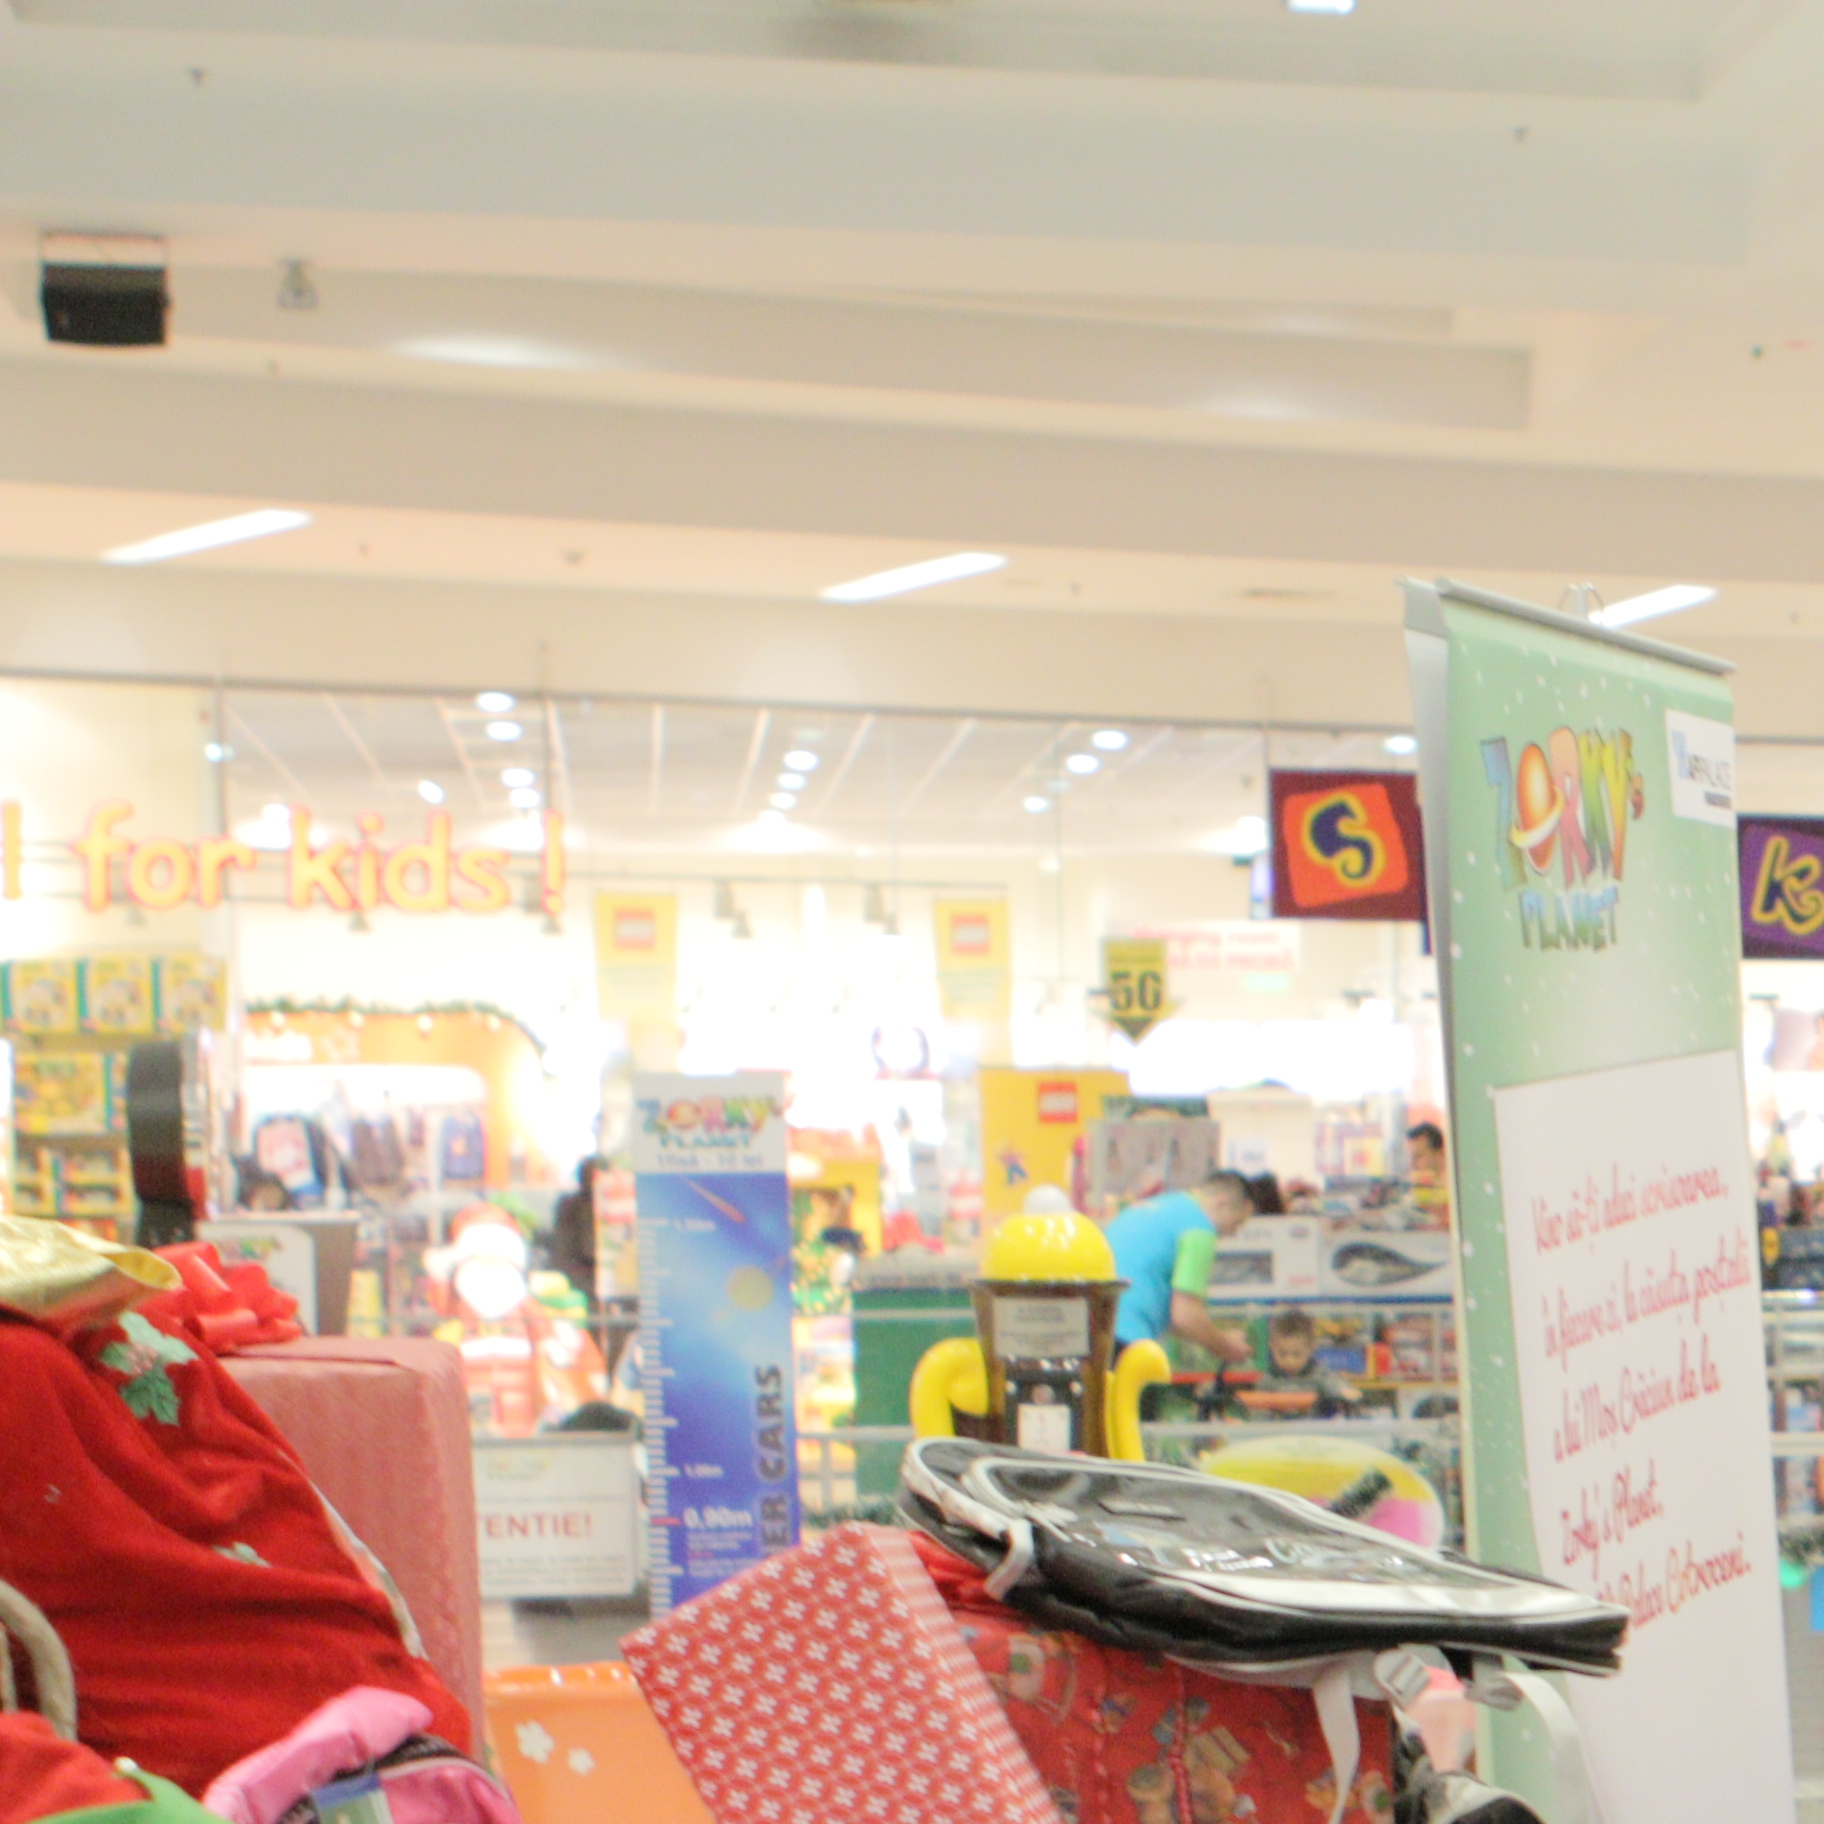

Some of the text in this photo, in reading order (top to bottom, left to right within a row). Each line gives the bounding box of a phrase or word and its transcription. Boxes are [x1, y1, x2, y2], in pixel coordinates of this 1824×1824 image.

[70, 801, 257, 912] for
[287, 804, 511, 914] kids
[1518, 885, 1619, 952] PLANET
[479, 1512, 593, 1540] ENTIE!
